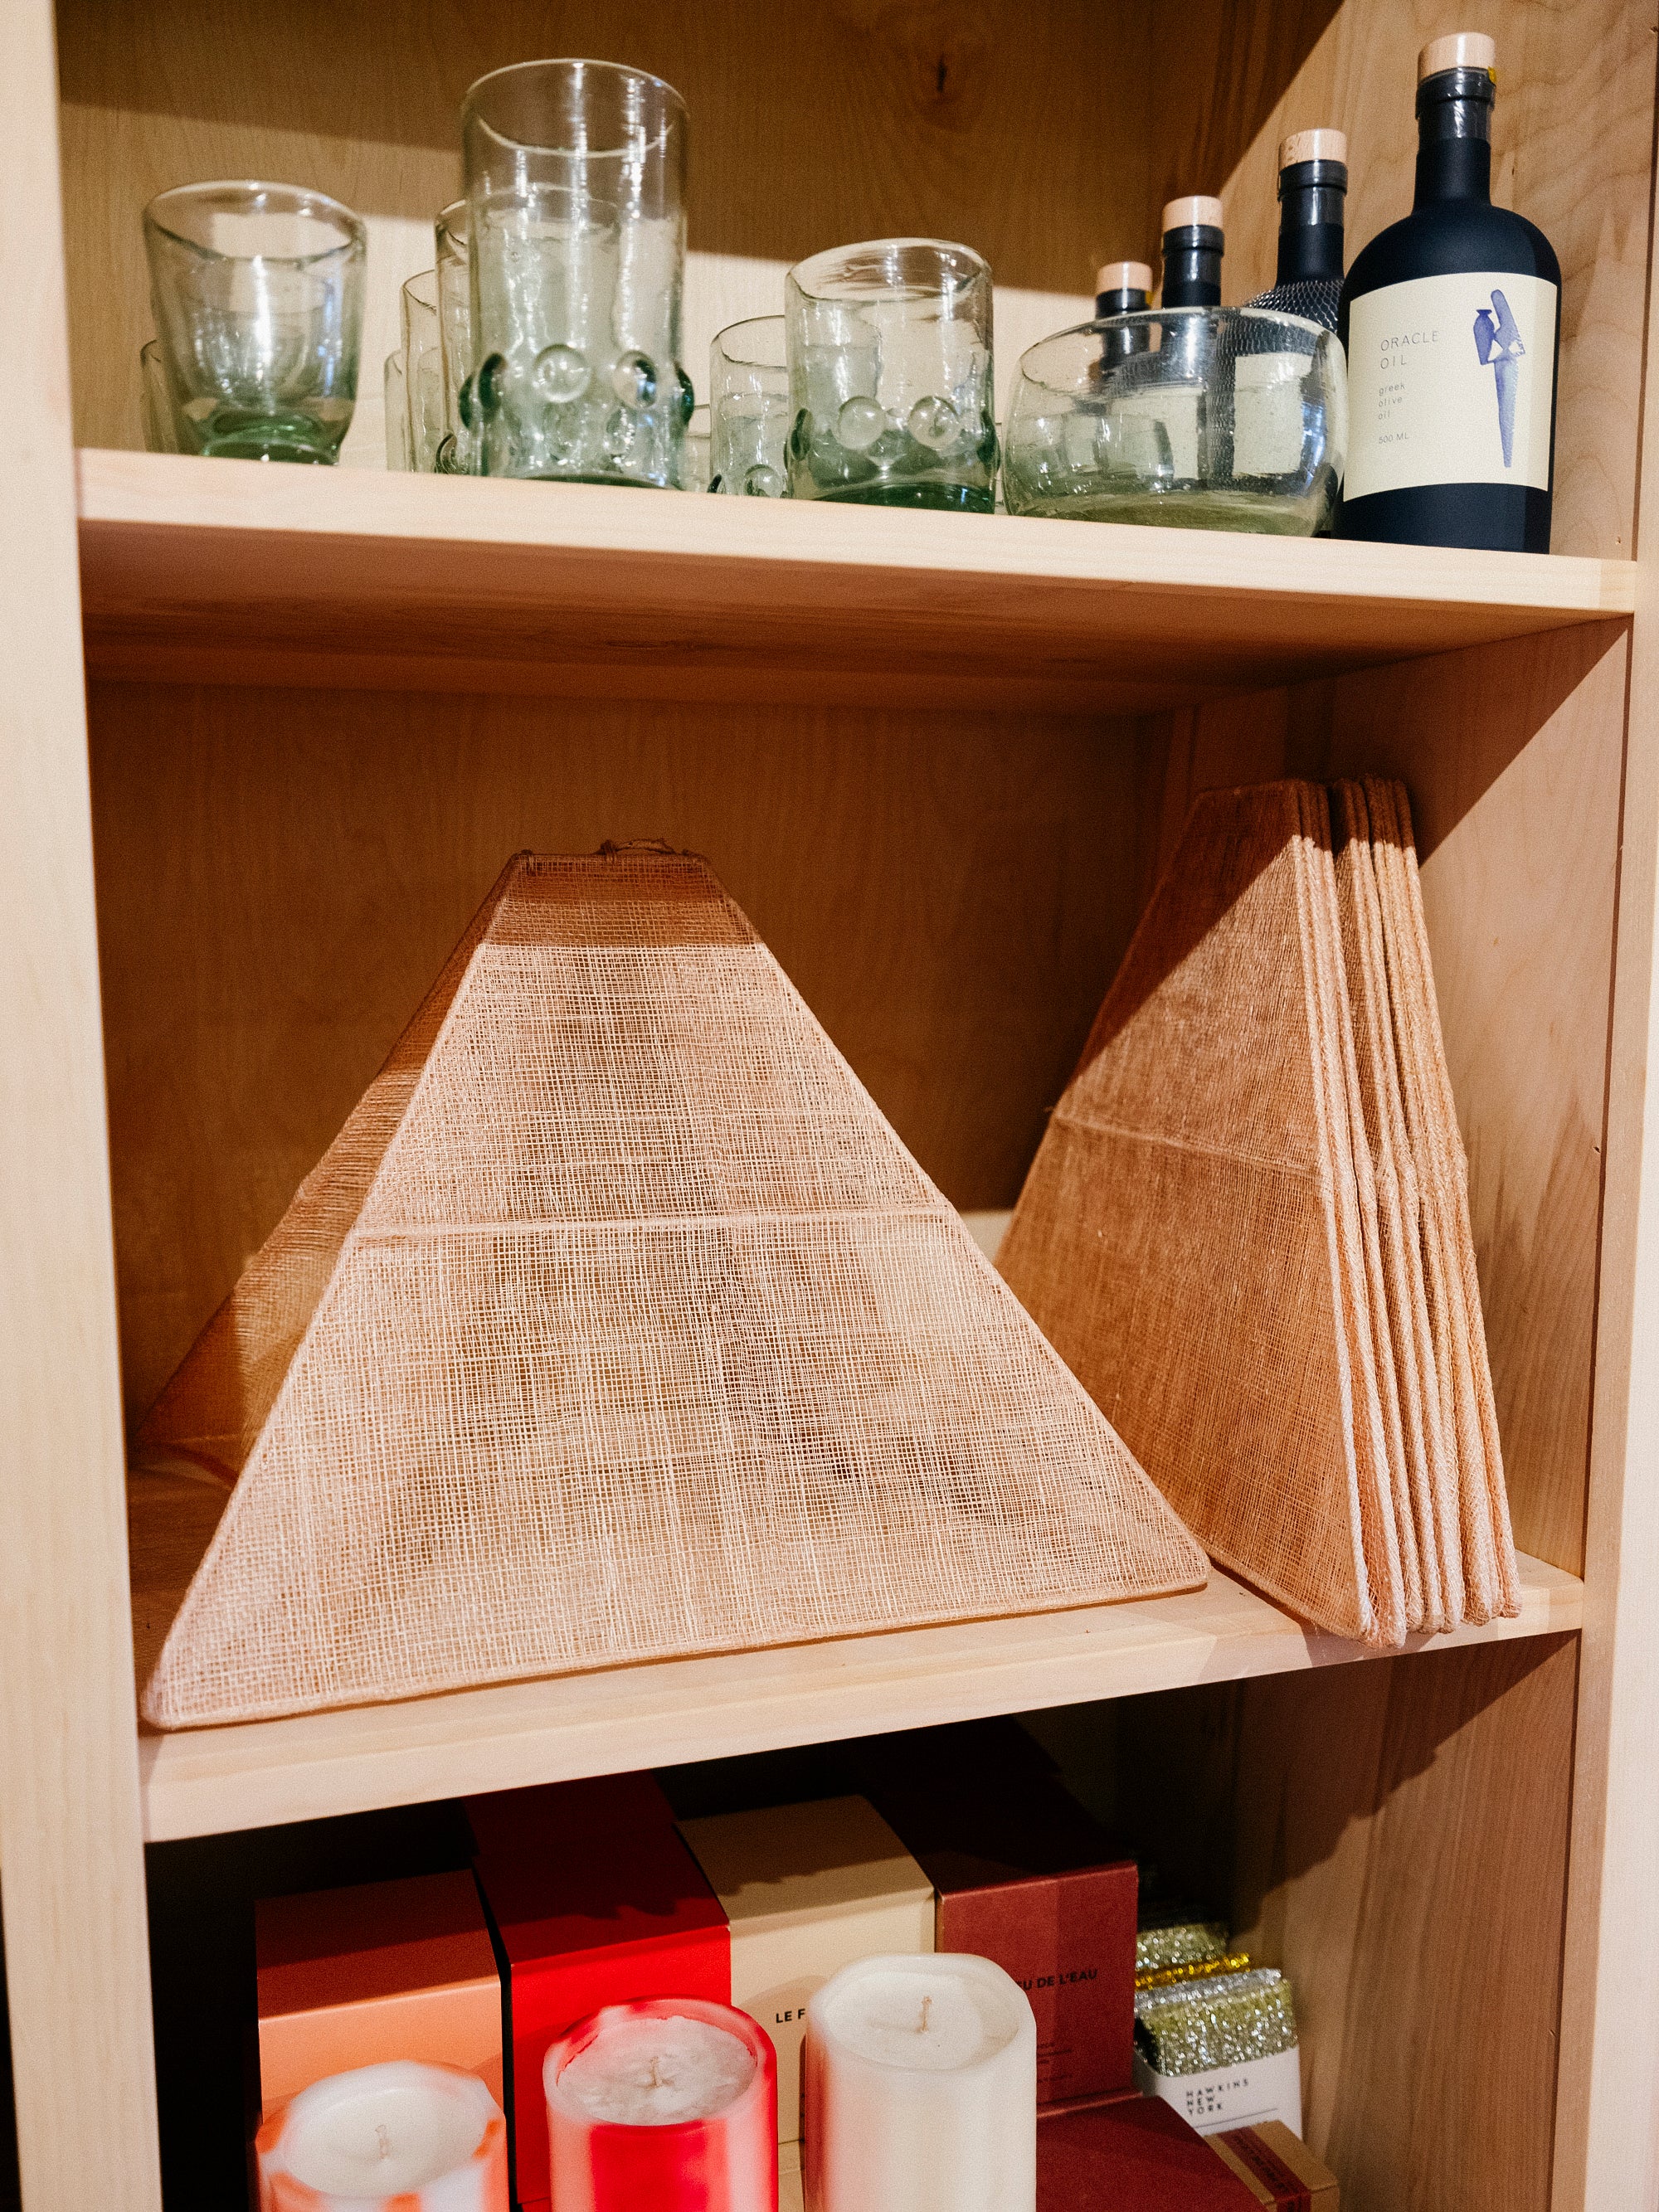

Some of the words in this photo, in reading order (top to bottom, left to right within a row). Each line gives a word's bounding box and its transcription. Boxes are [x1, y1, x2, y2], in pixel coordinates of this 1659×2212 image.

[1380, 331, 1439, 352] ORACLE
[1380, 355, 1407, 369] OIL
[1379, 383, 1405, 396] greek
[1378, 396, 1403, 407] olive
[1378, 410, 1390, 420] oil
[1379, 435, 1394, 445] 500
[1396, 432, 1410, 441] ML
[1037, 1976, 1055, 1989] DE
[1059, 1968, 1098, 1985] L'EAU
[776, 2010, 792, 2023] LE
[1186, 2078, 1248, 2097] HAWKINS
[1187, 2095, 1215, 2107] NEW
[1188, 2103, 1223, 2116] YORK
